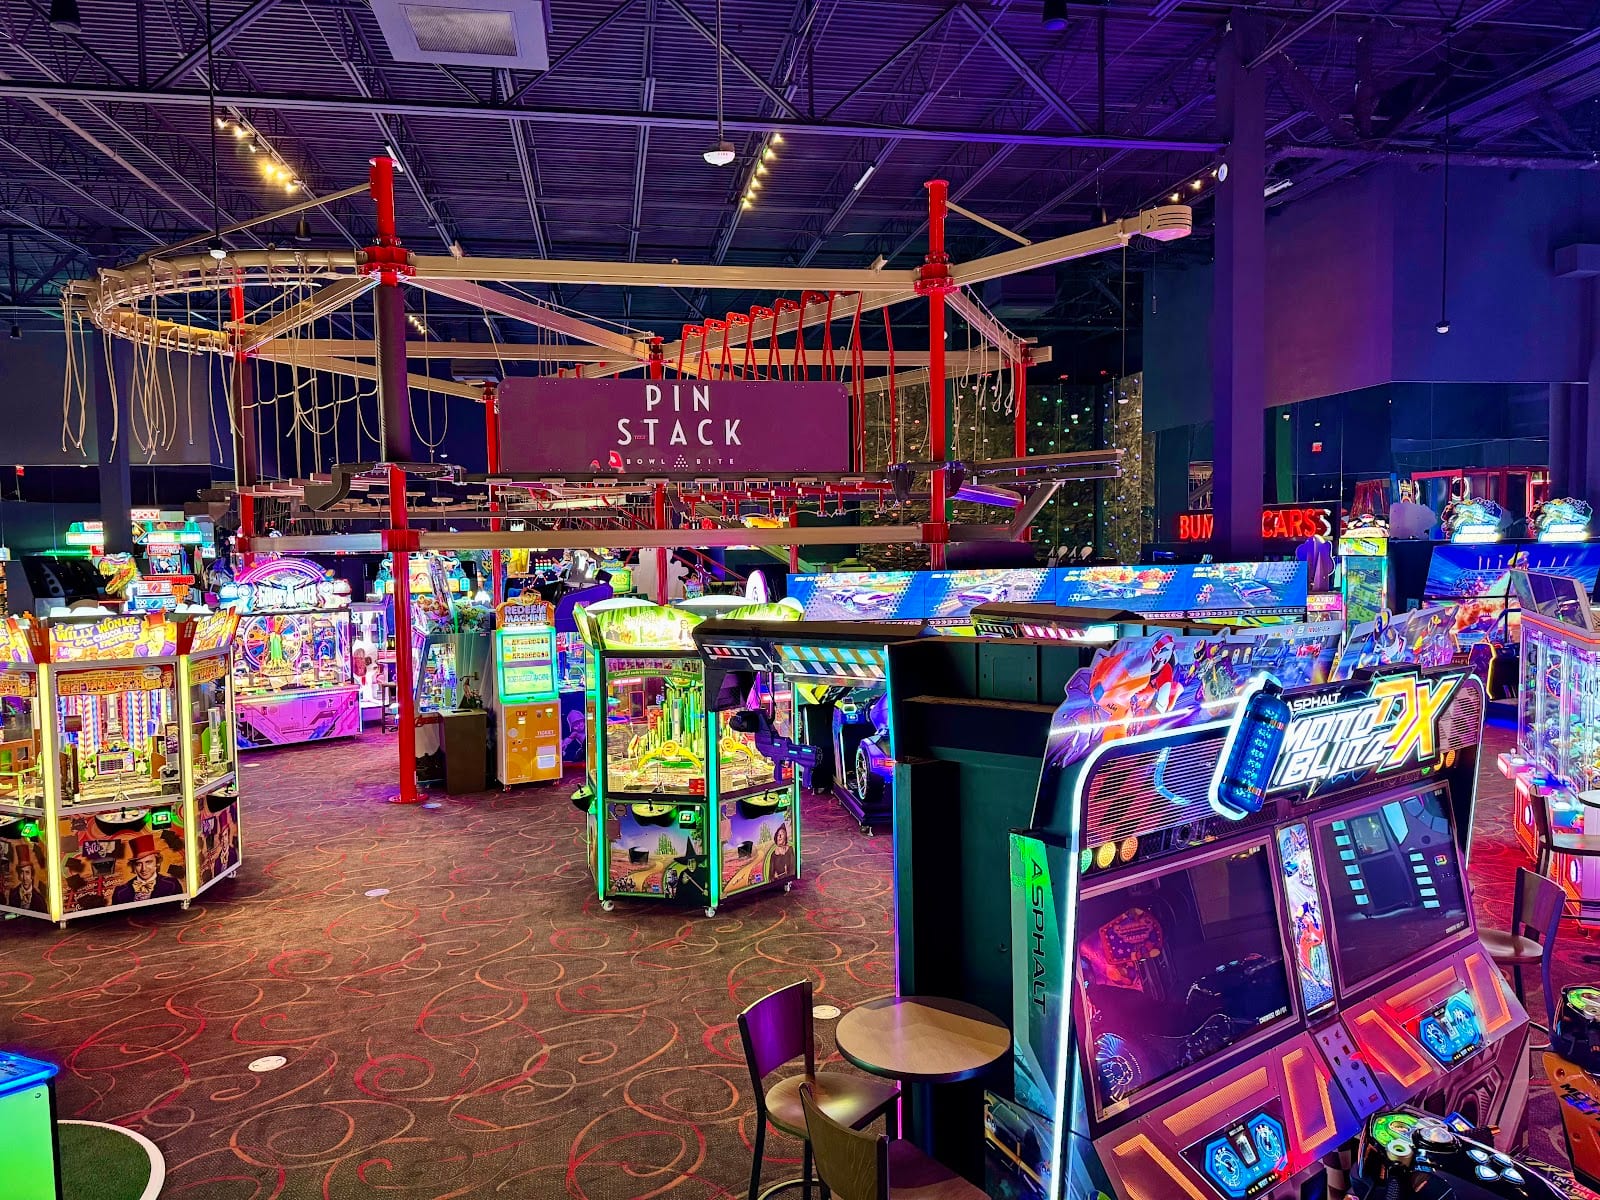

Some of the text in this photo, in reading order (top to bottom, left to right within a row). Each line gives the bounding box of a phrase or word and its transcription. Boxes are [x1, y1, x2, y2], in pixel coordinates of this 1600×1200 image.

[645, 385, 710, 412] PIN
[617, 418, 741, 446] STACK
[1179, 509, 1316, 539] BUM CARS
[504, 605, 547, 615] REDEEM
[505, 613, 547, 622] MACHINE
[56, 616, 140, 641] WILLY WONKA
[1287, 693, 1342, 711] ASPHALT
[1282, 674, 1461, 770] MOTO DX
[1281, 731, 1392, 786] BLITZ
[1031, 858, 1047, 1015] ASPHALT
